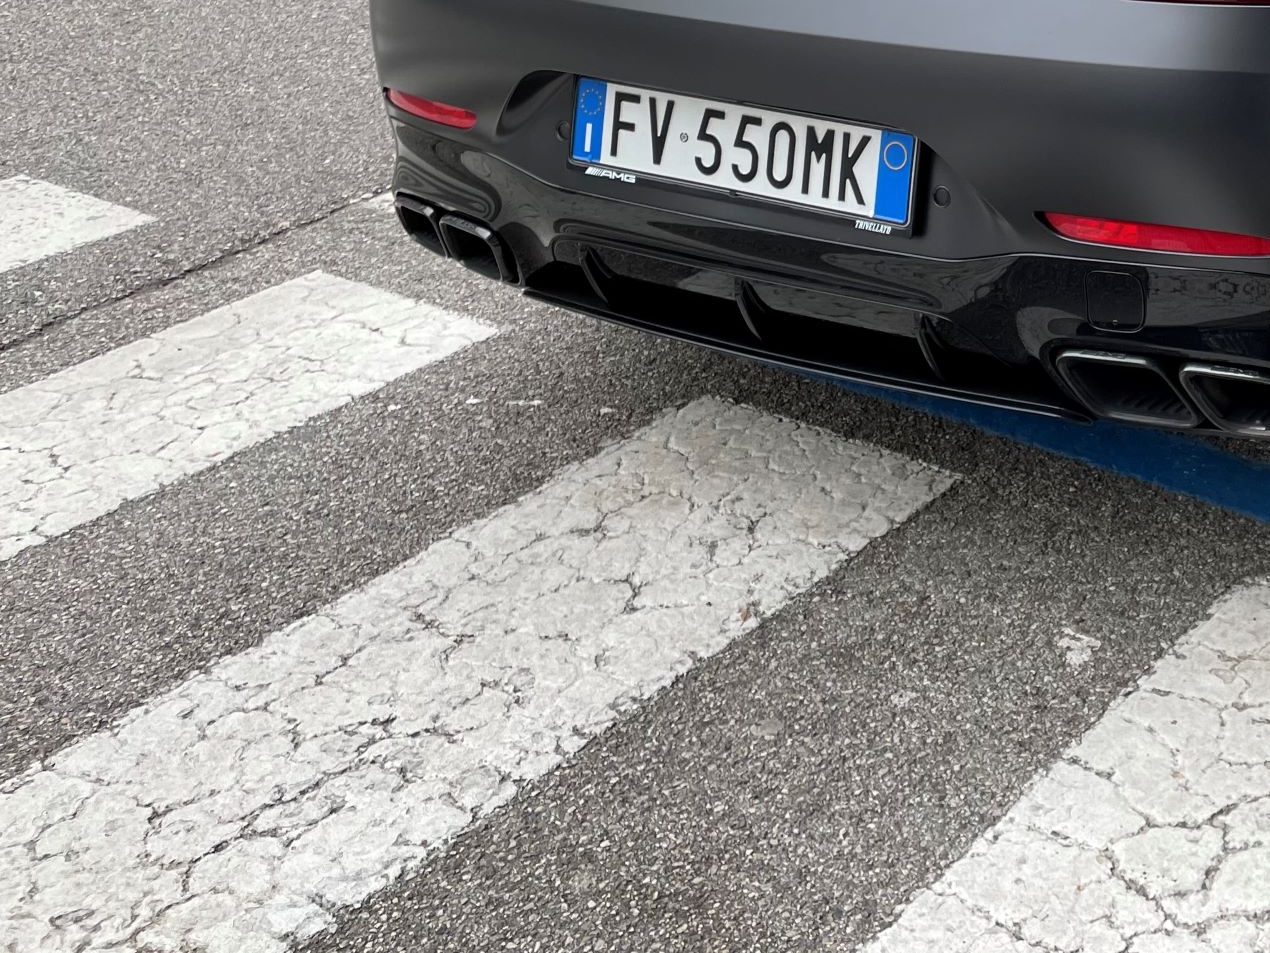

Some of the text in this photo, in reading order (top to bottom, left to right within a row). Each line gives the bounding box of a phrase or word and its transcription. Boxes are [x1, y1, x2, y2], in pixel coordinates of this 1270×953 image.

[610, 91, 675, 166] FV
[694, 108, 873, 206] 550MK
[600, 169, 636, 184] AMG
[855, 219, 892, 235] TRIVELLATO
